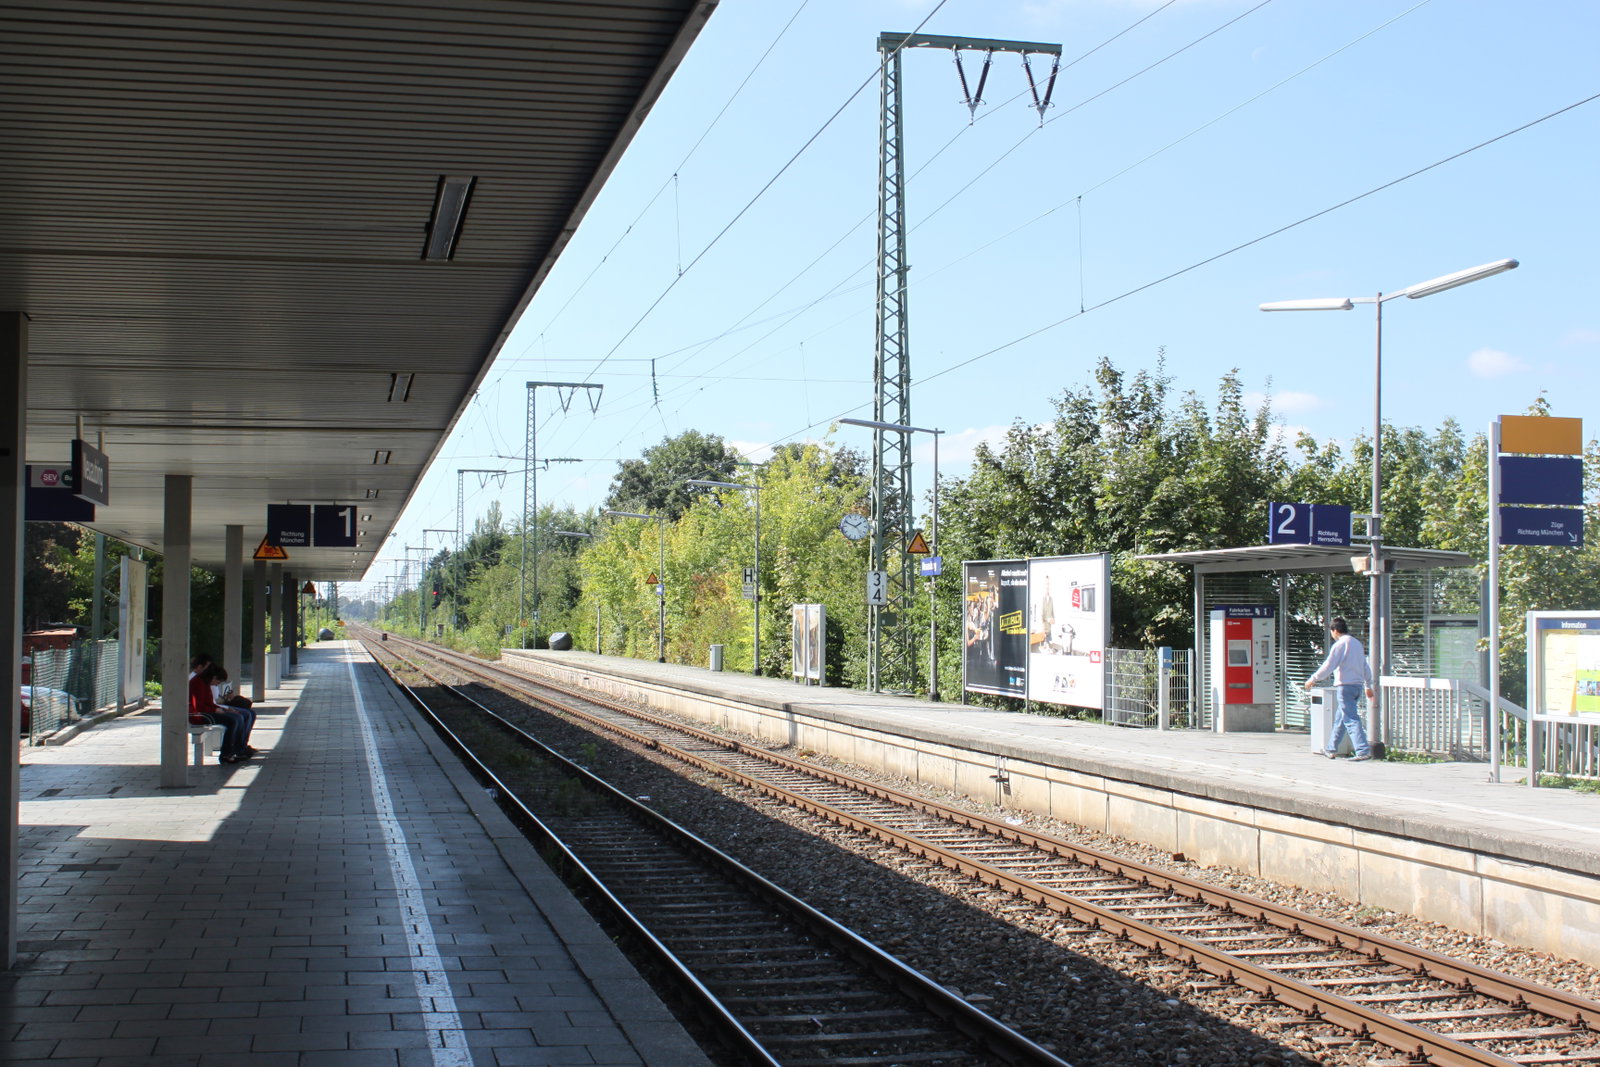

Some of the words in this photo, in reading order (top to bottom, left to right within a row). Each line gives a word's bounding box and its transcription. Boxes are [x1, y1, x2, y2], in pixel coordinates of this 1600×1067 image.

[338, 507, 351, 537] 1
[1277, 504, 1296, 535] 2
[1550, 521, 1564, 529] Züge
[744, 568, 753, 583] H
[873, 572, 881, 587] 3
[872, 588, 882, 602] 4
[1561, 621, 1587, 629] Information
